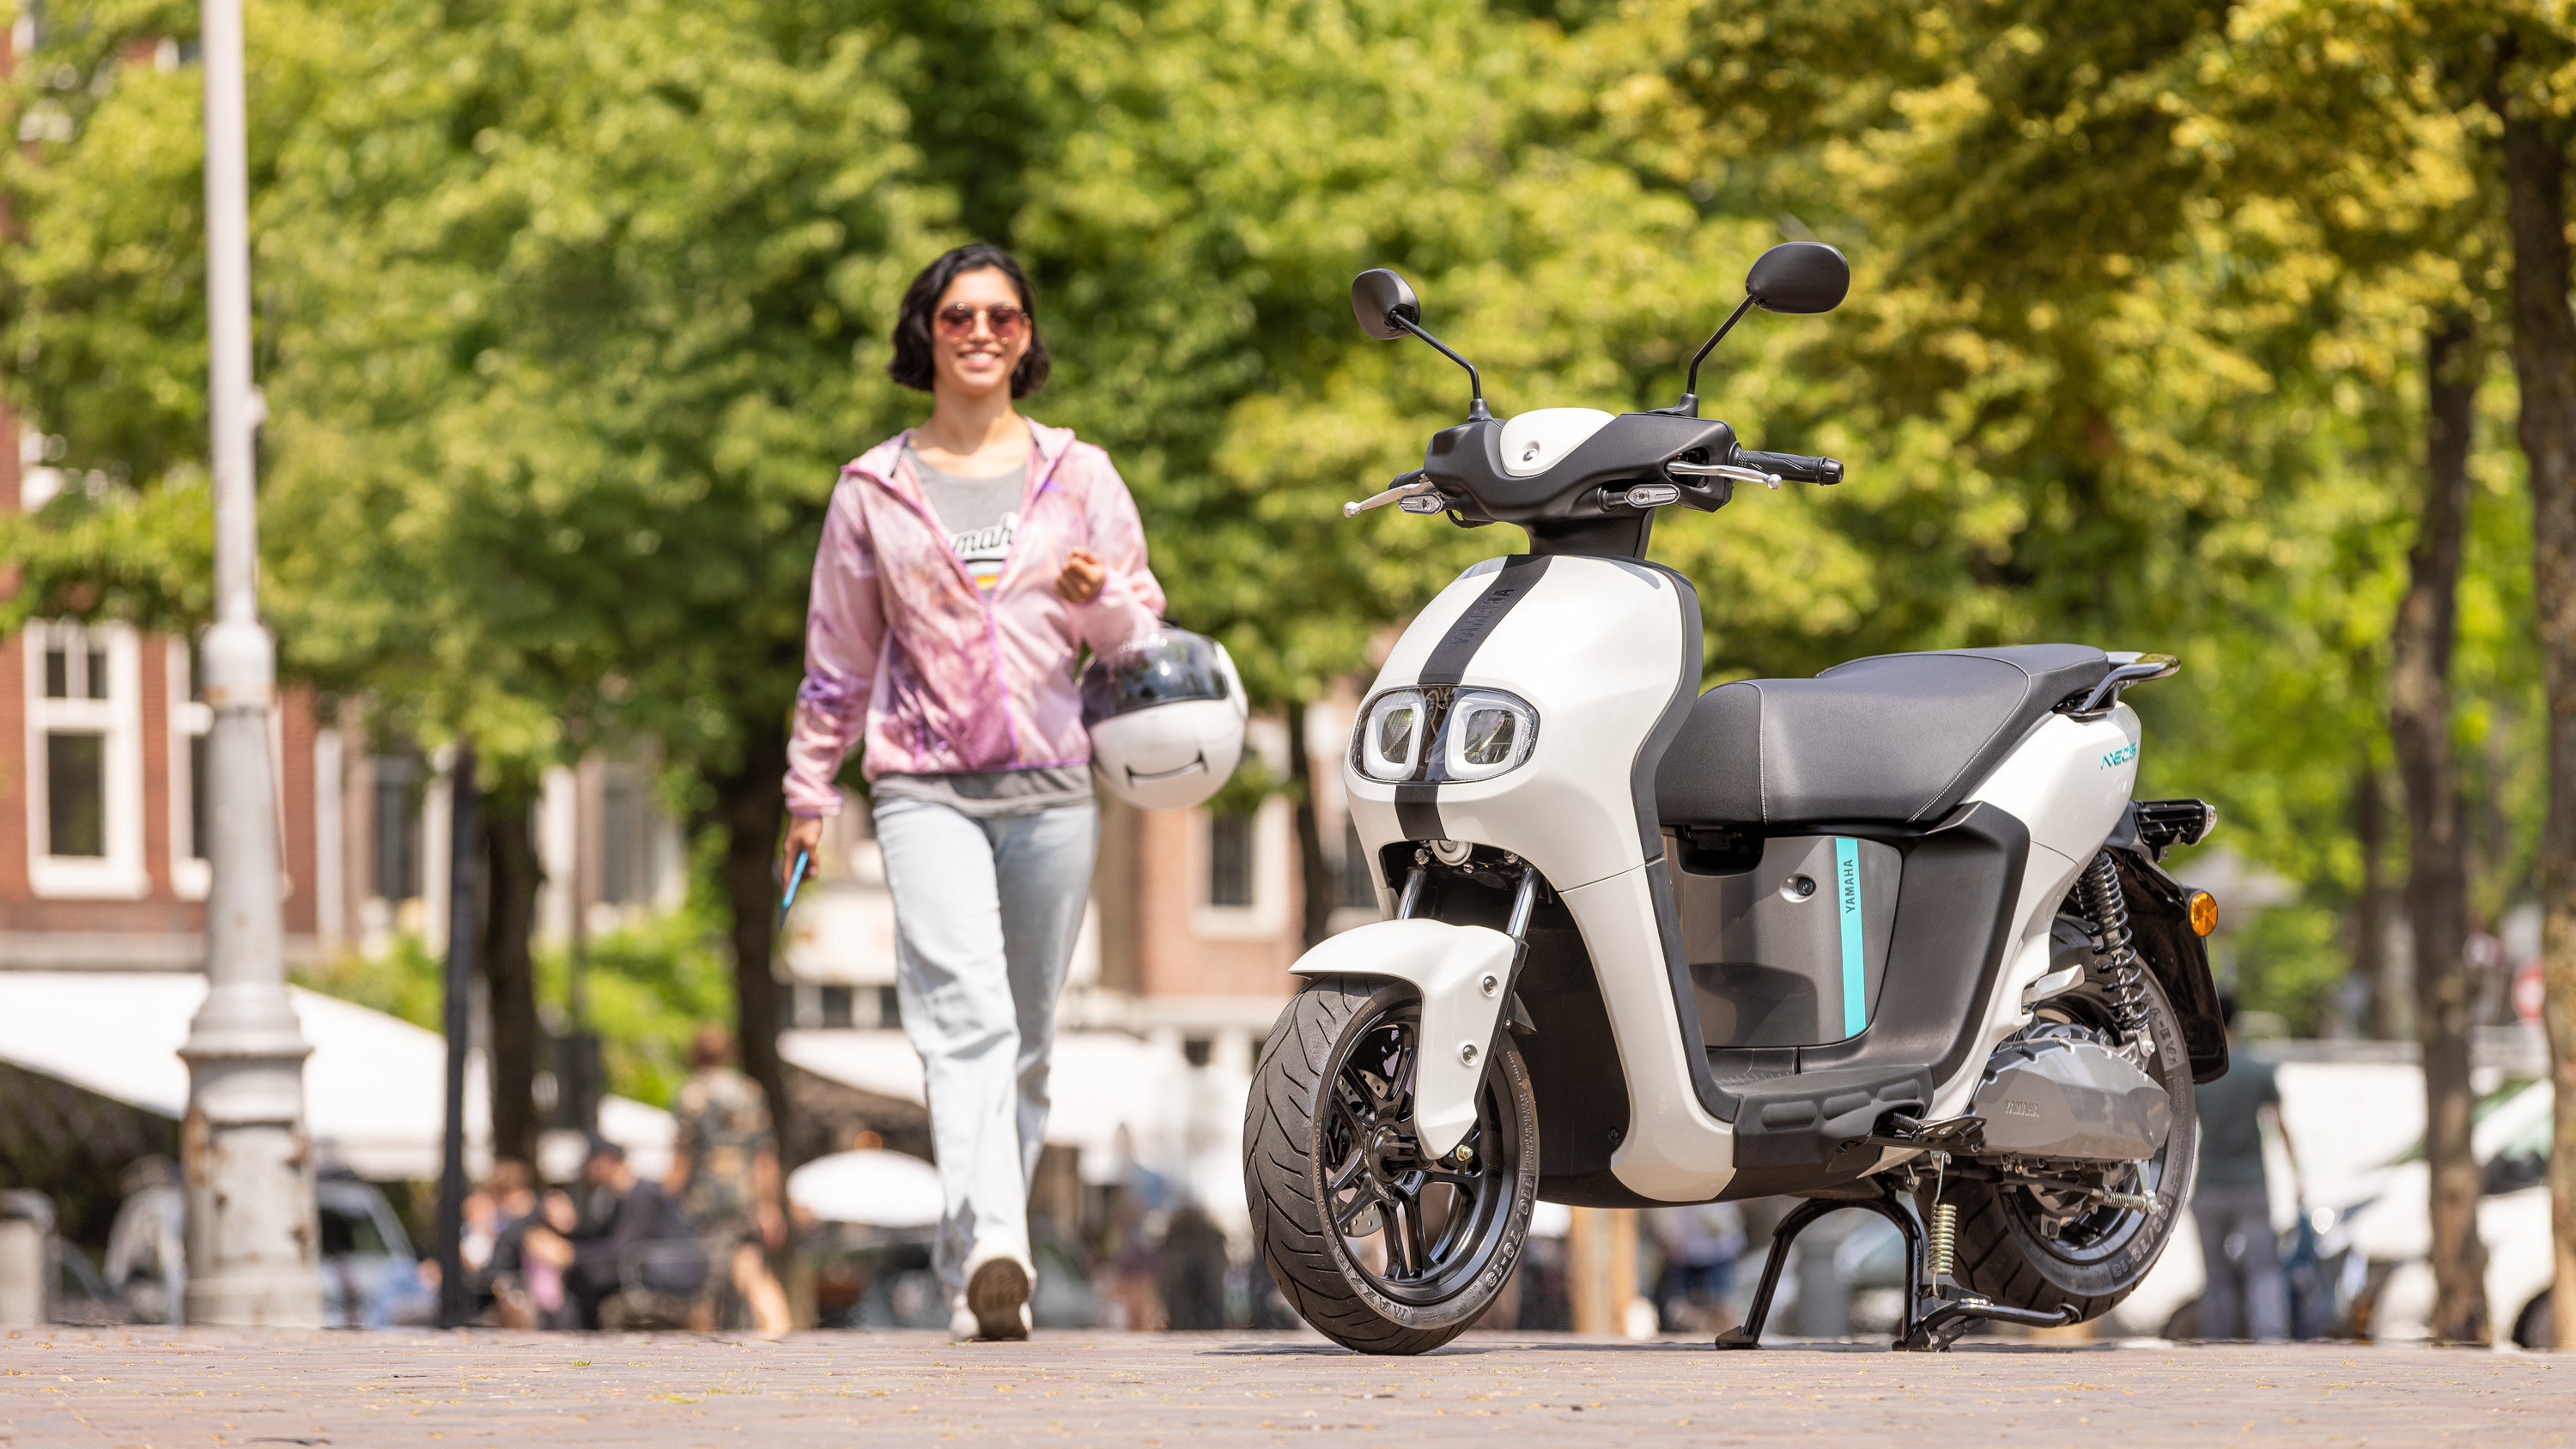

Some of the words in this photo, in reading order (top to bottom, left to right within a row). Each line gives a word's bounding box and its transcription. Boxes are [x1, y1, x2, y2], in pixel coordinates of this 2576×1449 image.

[952, 515, 1014, 554] mah
[1446, 589, 1515, 647] YAMAHA
[1843, 858, 1856, 914] YAMAHA
[2005, 1099, 2039, 1118] YAMAHA
[1485, 1177, 1534, 1288] 110/70-13
[1336, 1248, 1408, 1322] MAXXIS
